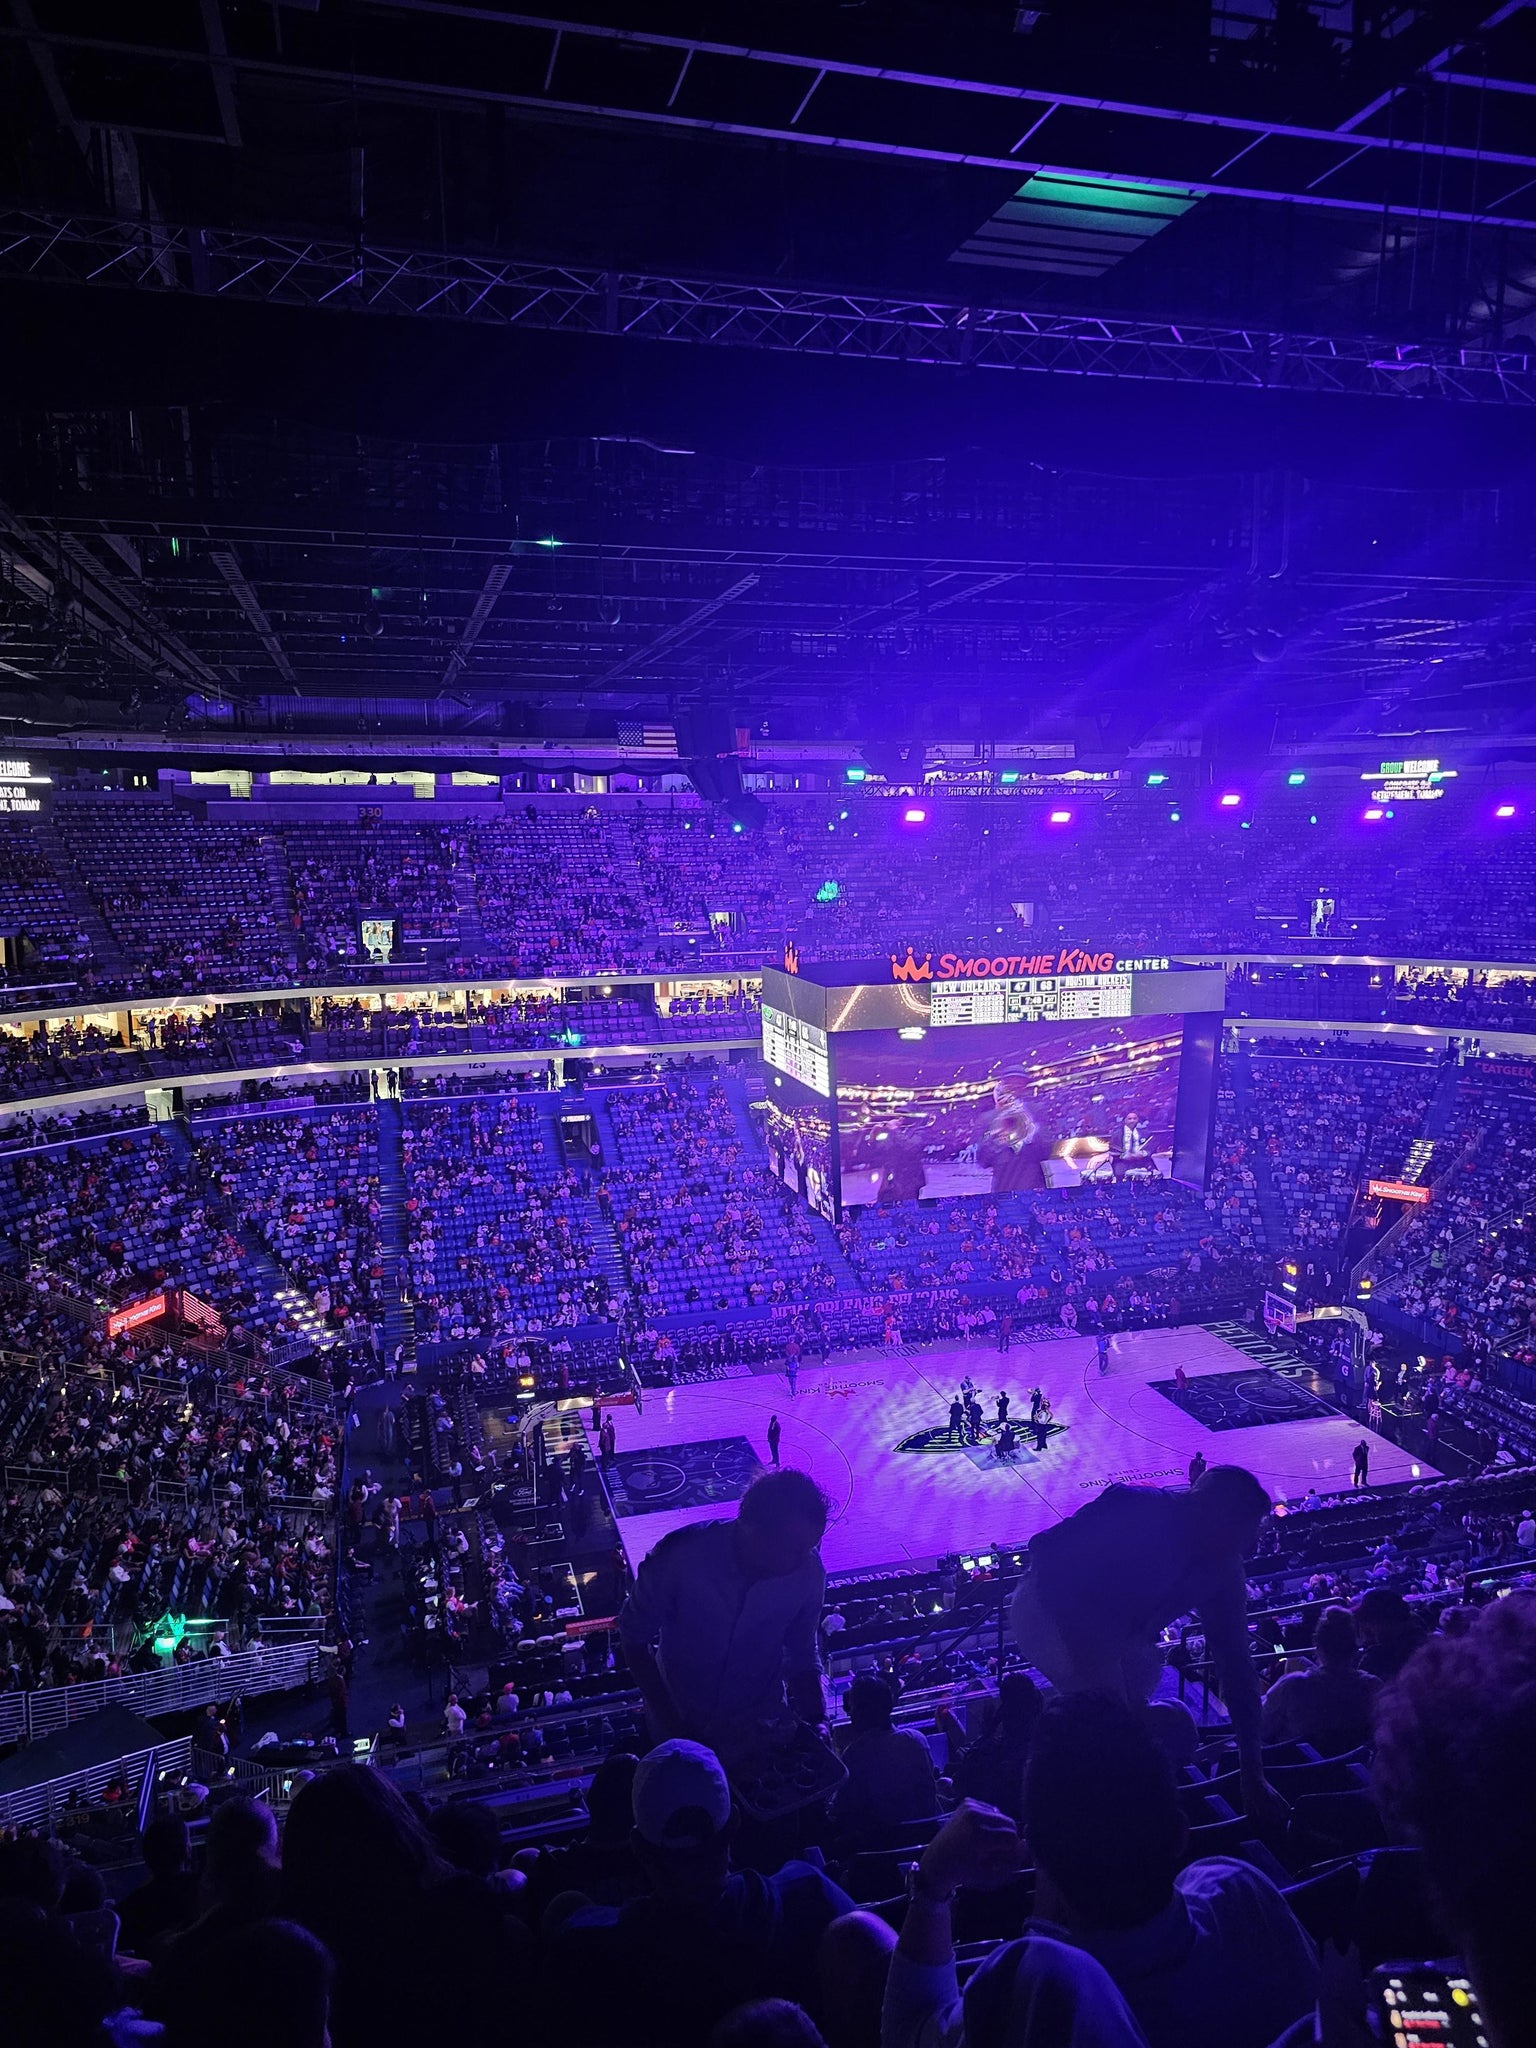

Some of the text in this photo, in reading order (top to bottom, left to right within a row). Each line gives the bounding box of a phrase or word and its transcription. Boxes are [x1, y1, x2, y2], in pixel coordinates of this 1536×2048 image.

[11, 799, 41, 812] TOMMY
[359, 807, 382, 817] 330
[936, 953, 1056, 978] SMOOTHIE
[1115, 958, 1169, 972] CENTER
[936, 980, 1000, 993] NEW ORLEANS
[1200, 1321, 1320, 1378] PELICANS
[1119, 1467, 1185, 1483] SMOOTHIE
